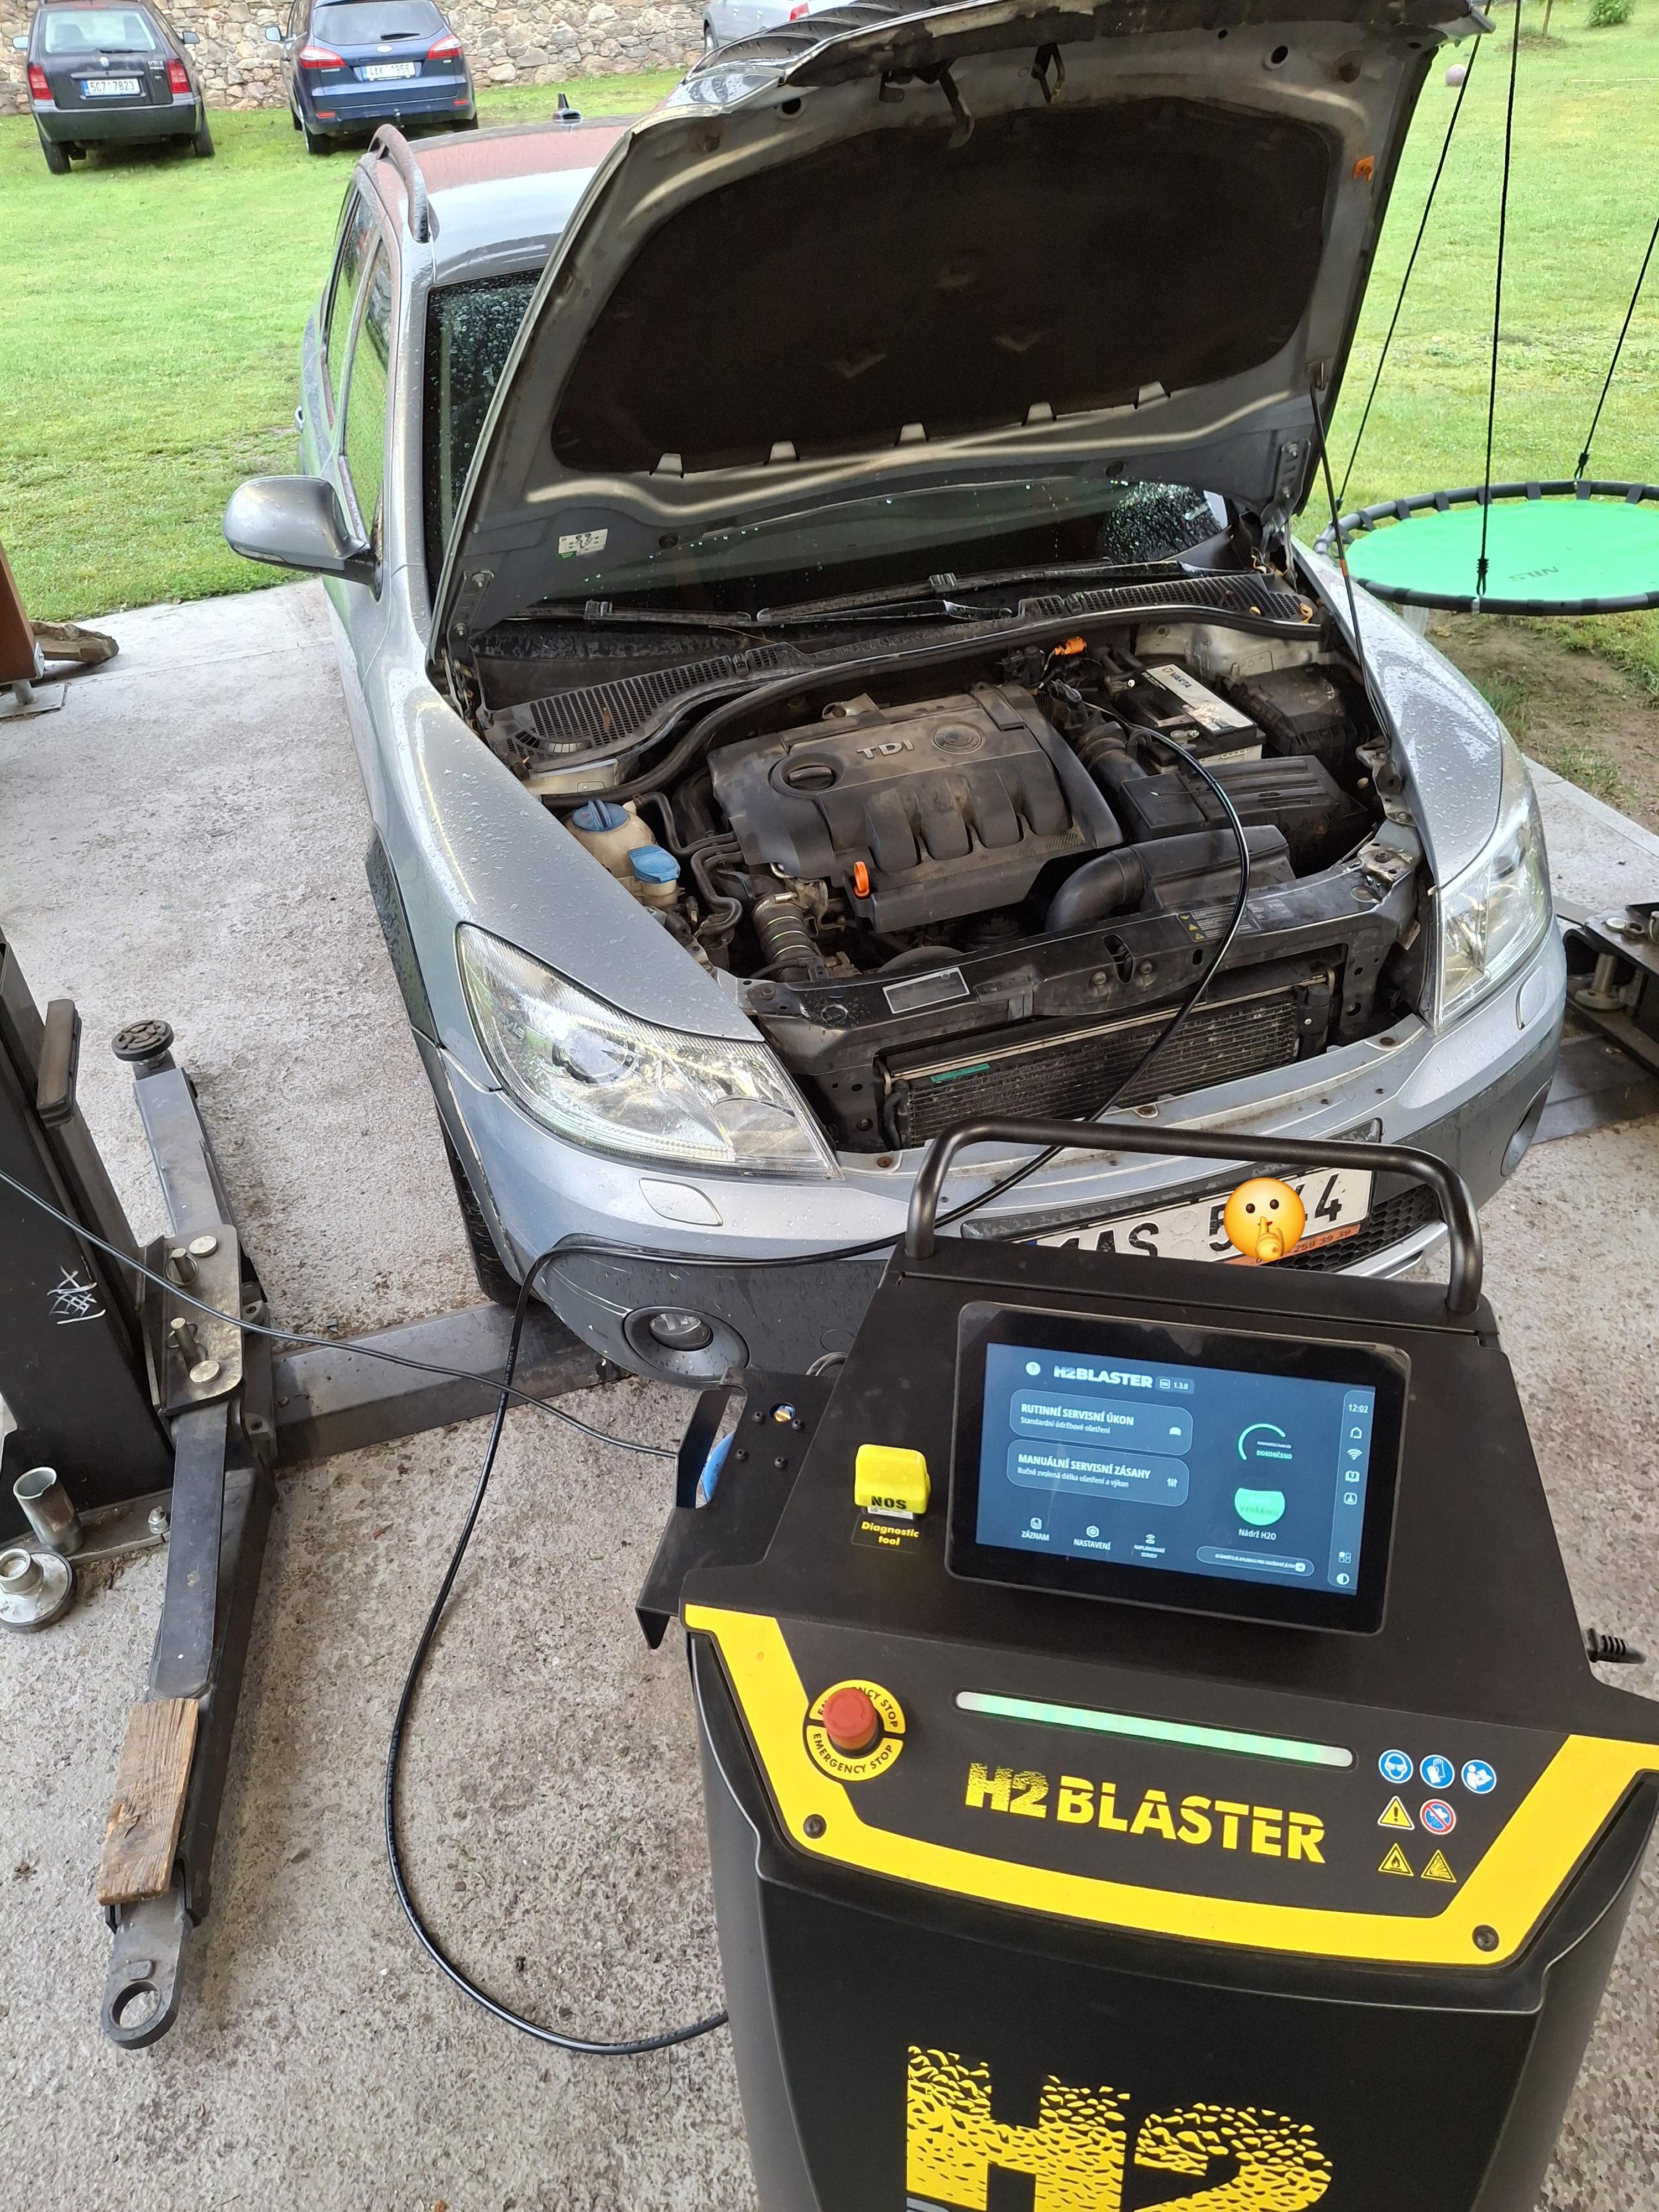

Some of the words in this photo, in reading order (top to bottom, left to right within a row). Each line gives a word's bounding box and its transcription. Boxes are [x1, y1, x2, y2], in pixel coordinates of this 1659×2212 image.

[90, 81, 106, 92] 5C7
[112, 81, 135, 91] 7823
[1170, 671, 1192, 688] VARTA
[857, 739, 914, 759] TDI
[1053, 1365, 1153, 1388] H2BLASTER
[1173, 1381, 1188, 1390] 1.3.0
[1021, 1403, 1062, 1417] RUTINNÍ
[1062, 1408, 1105, 1422] SERVISNÍ
[1107, 1412, 1134, 1426] ÚKON
[1348, 1404, 1369, 1413] 12:02
[1020, 1416, 1055, 1427] Standardní
[1055, 1420, 1084, 1431] údržbové
[1085, 1425, 1110, 1434] ošetření
[1256, 1449, 1292, 1460] DOKONČENO
[1018, 1453, 1070, 1469] MANUÁLNÍ
[1071, 1460, 1114, 1475] SERVISNÍ
[1114, 1464, 1151, 1479] ZÁSAHY
[1017, 1467, 1037, 1476] Ručně
[1037, 1470, 1061, 1479] zvolená
[1062, 1473, 1079, 1481] délka
[1079, 1475, 1105, 1485] ošetření
[1110, 1479, 1129, 1488] výkon
[871, 1495, 907, 1510] NOS
[1245, 1505, 1279, 1517] POŘÁDKU
[861, 1521, 920, 1538] Diagnostic
[1021, 1530, 1050, 1541] ZÁZNAM
[1238, 1528, 1260, 1538] Nádrž
[1260, 1531, 1277, 1541] H2O
[878, 1535, 900, 1546] tool
[1073, 1538, 1112, 1551] NASTAVENÍ
[880, 1699, 898, 1728] STOP
[813, 1733, 867, 1774] EMERGENCY
[870, 1744, 893, 1770] STOP
